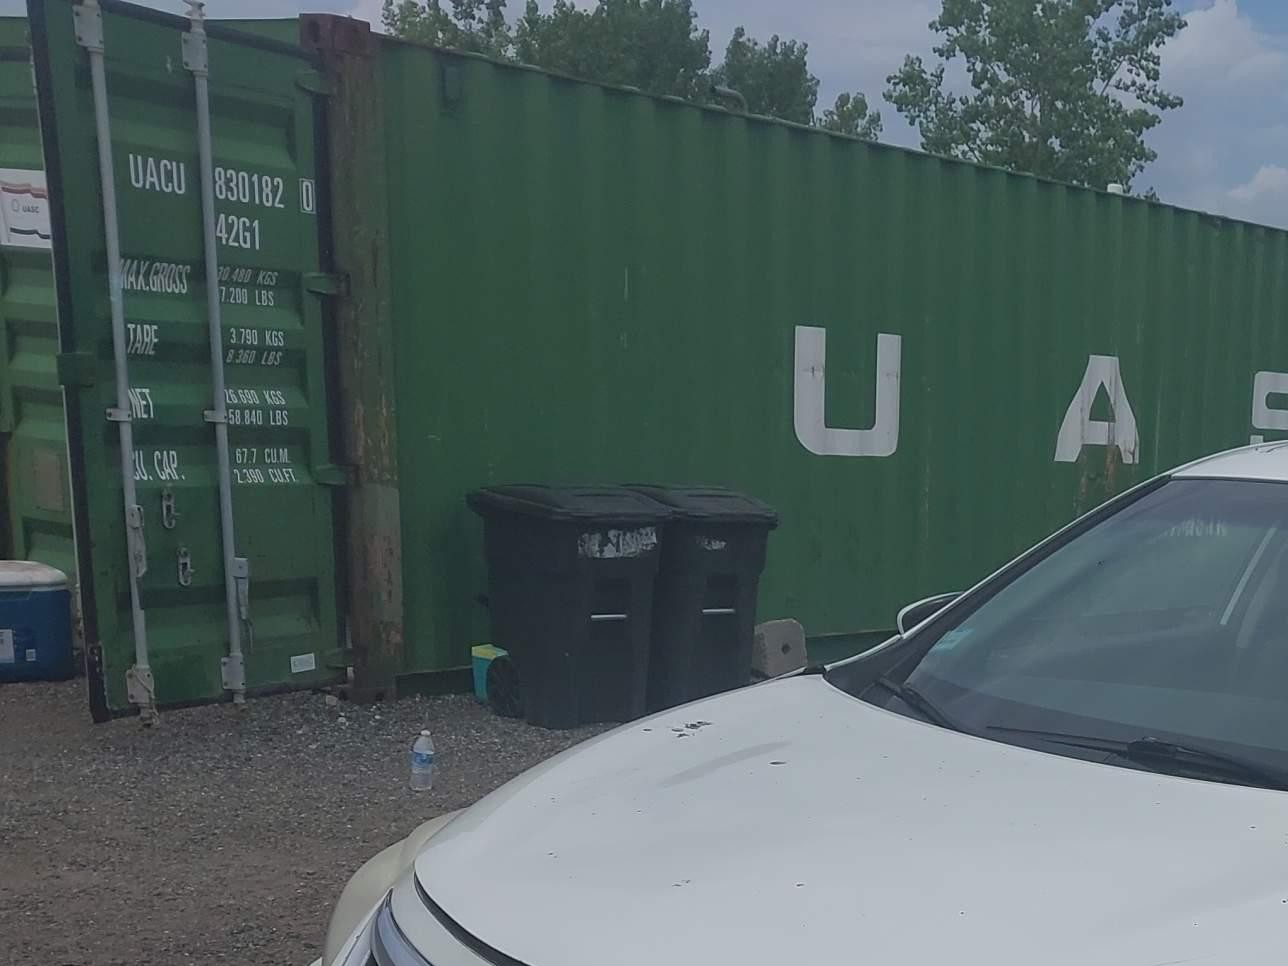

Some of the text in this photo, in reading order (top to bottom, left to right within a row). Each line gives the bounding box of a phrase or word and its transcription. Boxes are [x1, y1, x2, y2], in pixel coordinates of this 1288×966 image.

[129, 154, 186, 194] UACU
[215, 168, 285, 209] 830182
[216, 214, 260, 250] 42G1
[256, 271, 278, 286] KGS
[255, 289, 275, 306] LBS
[127, 324, 159, 355] TARE
[229, 328, 285, 347] 3.790 KGS
[261, 351, 283, 366] LBS
[128, 388, 154, 419] NET
[263, 390, 286, 405] KGS
[228, 409, 289, 425] 58.840 LBS
[235, 448, 257, 464] 67.7
